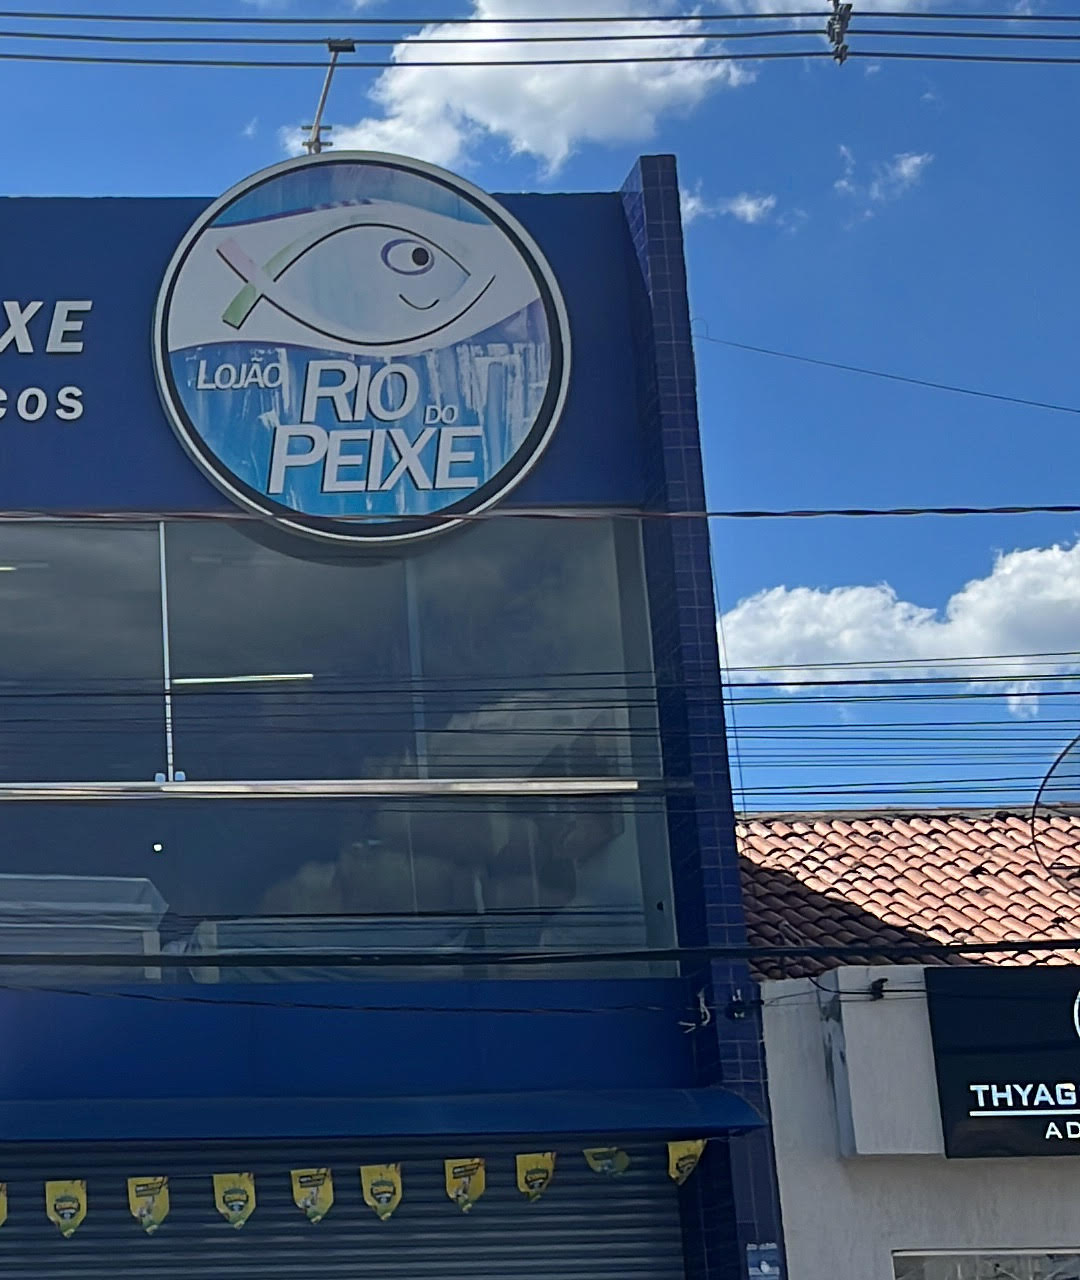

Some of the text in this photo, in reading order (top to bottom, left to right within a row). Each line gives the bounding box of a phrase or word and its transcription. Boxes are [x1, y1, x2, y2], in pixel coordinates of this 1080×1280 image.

[196, 356, 420, 423] LOJÃO RIO
[423, 404, 459, 426] DO
[267, 424, 484, 495] PEIXE
